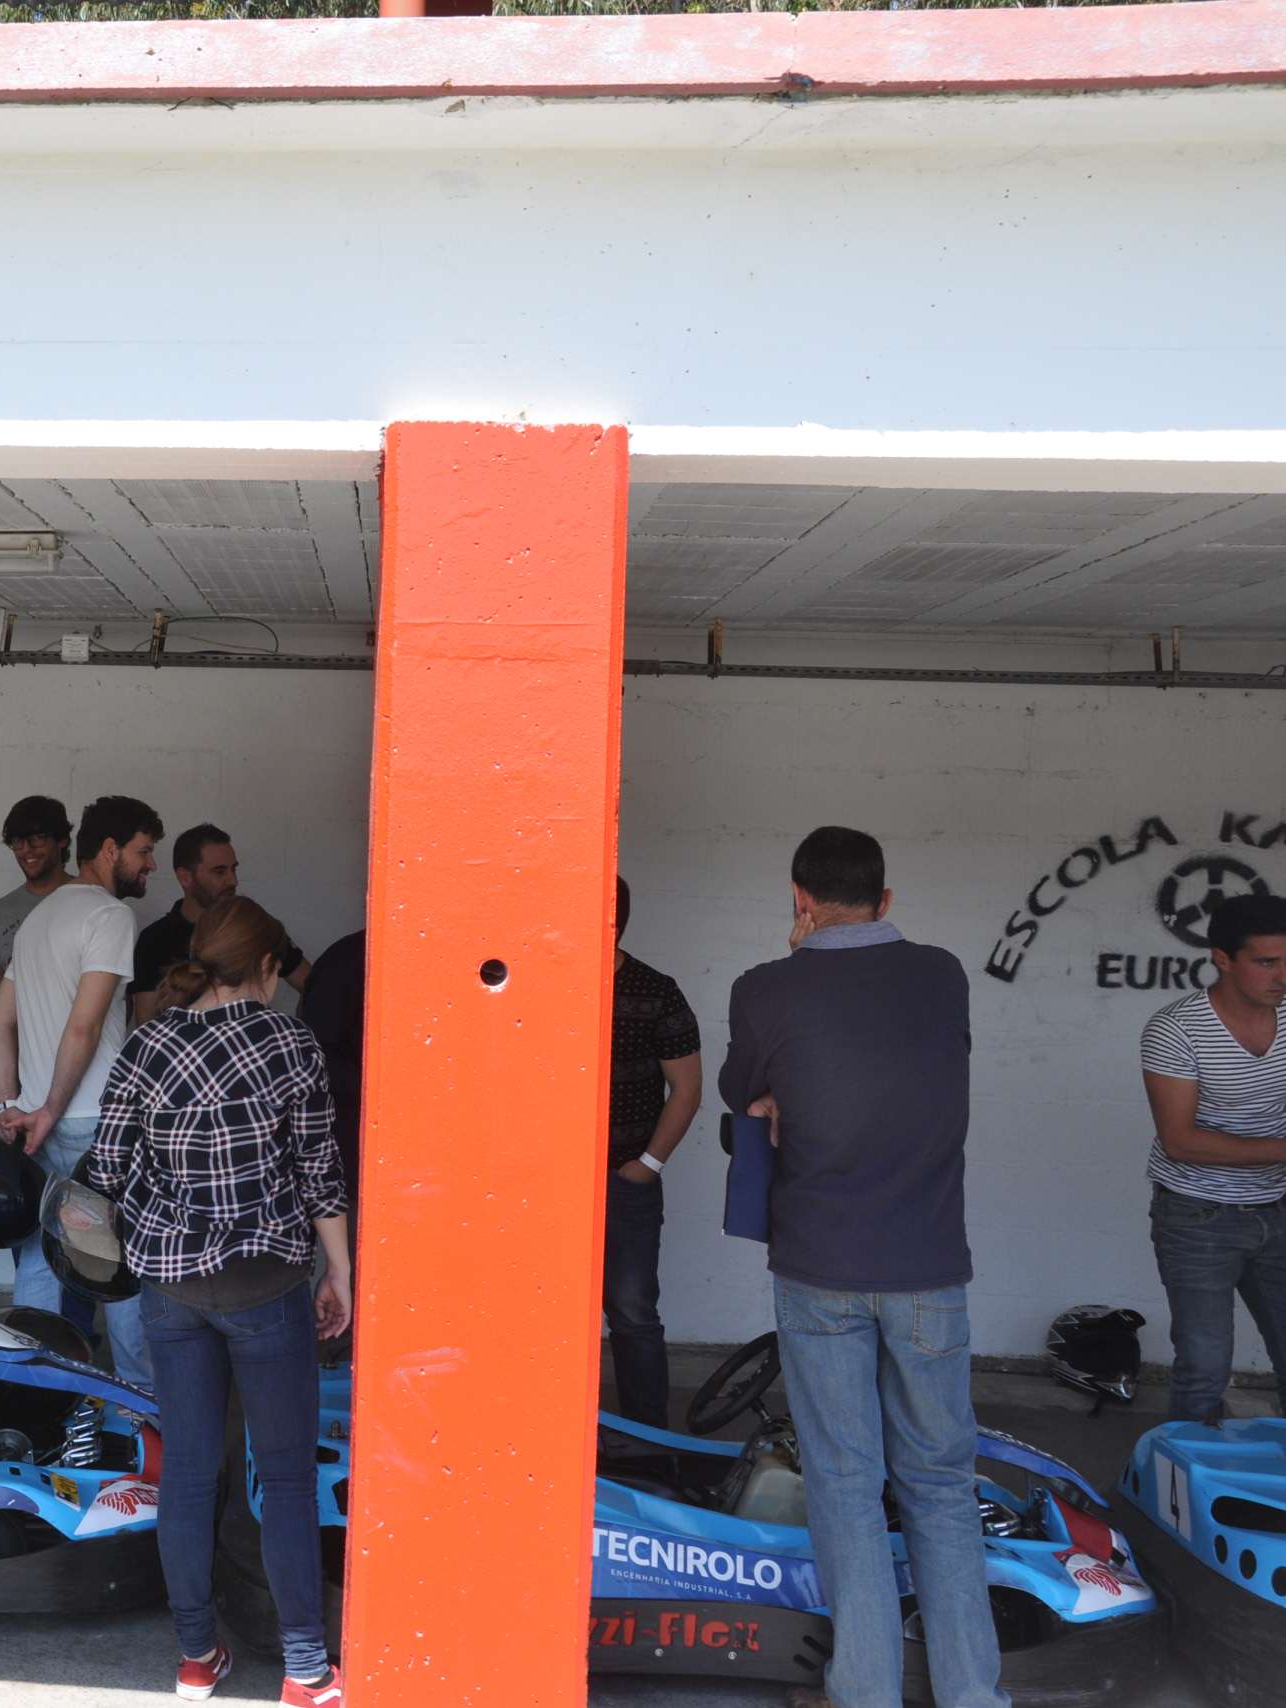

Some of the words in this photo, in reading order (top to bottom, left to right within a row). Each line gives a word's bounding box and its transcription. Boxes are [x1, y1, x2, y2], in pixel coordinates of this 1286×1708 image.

[984, 815, 1178, 983] ESCOLA
[591, 1527, 783, 1590] TECNIROLO
[610, 1568, 670, 1586] ENGENHARIA
